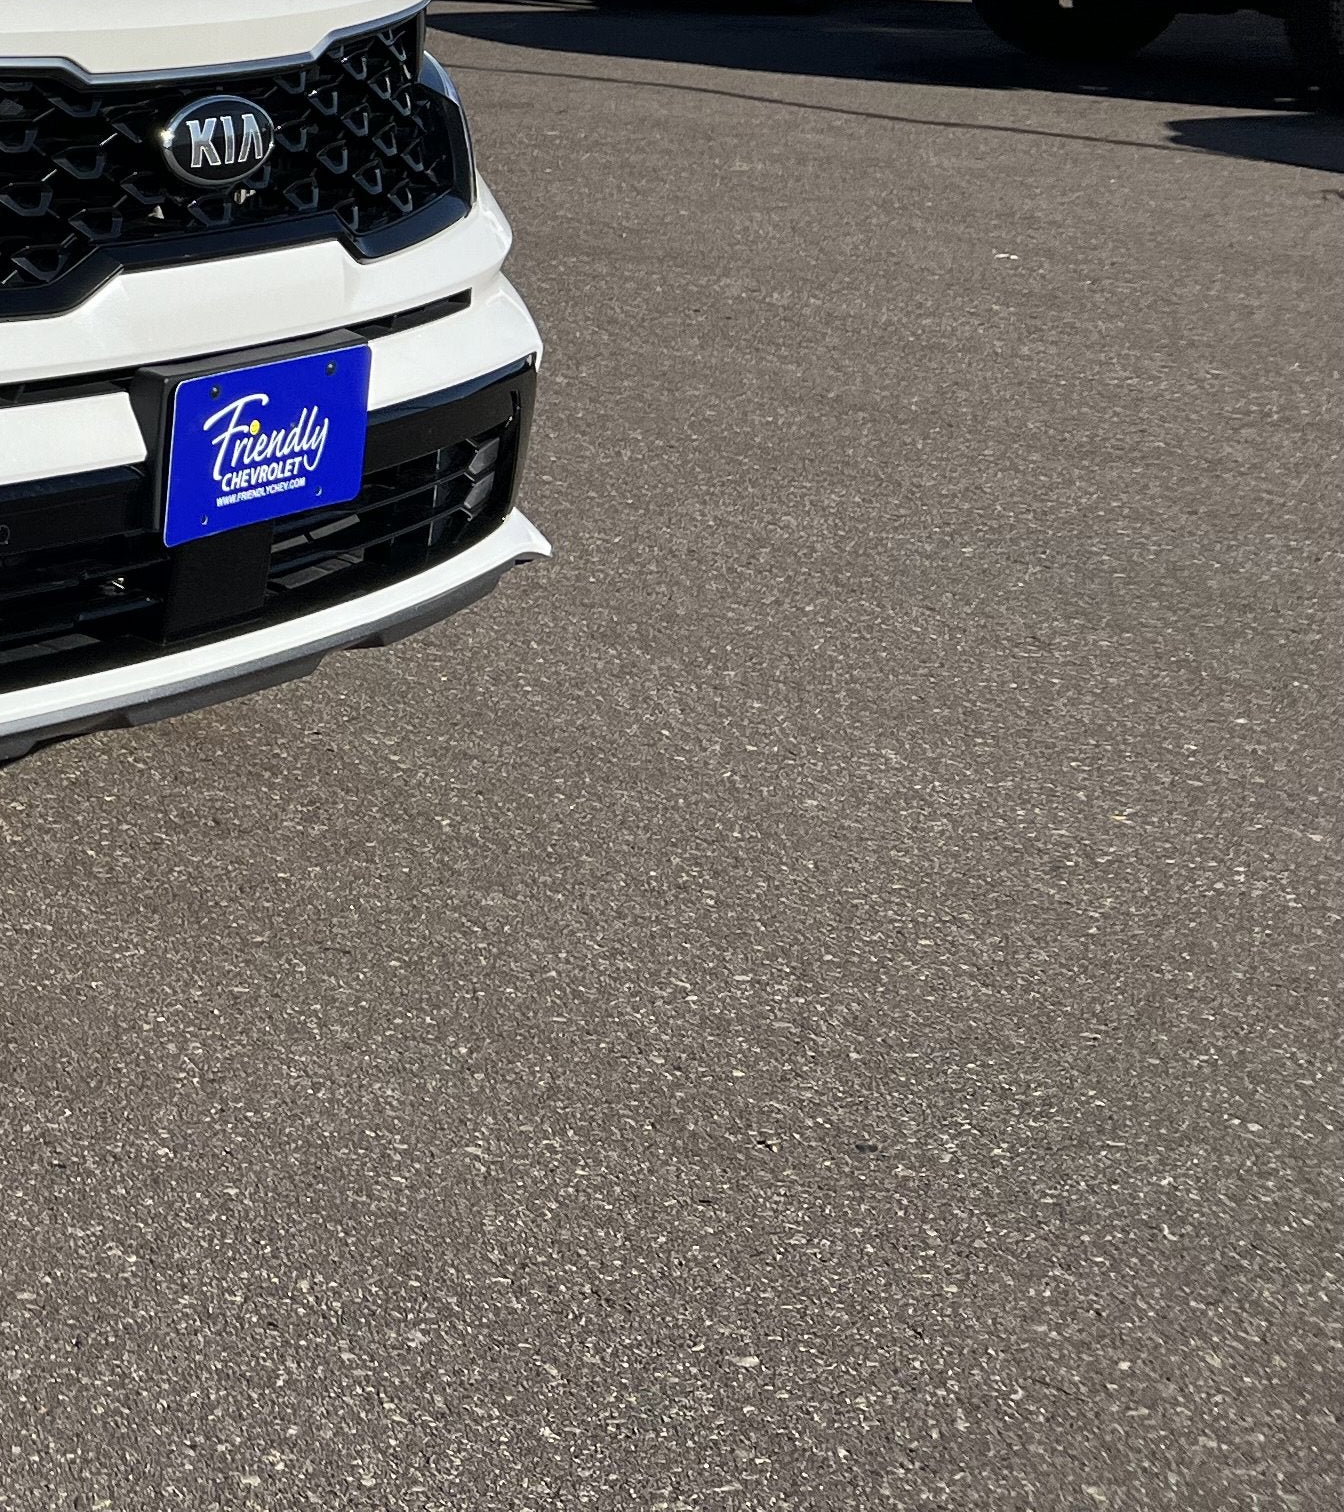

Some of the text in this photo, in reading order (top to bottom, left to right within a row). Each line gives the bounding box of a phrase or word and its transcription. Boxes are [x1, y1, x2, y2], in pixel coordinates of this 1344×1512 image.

[186, 114, 263, 168] KIA
[203, 393, 329, 481] Friendly
[216, 476, 306, 507] WWW.FRIENDLYCHEV.COM
[221, 456, 303, 492] CHEVROLET
